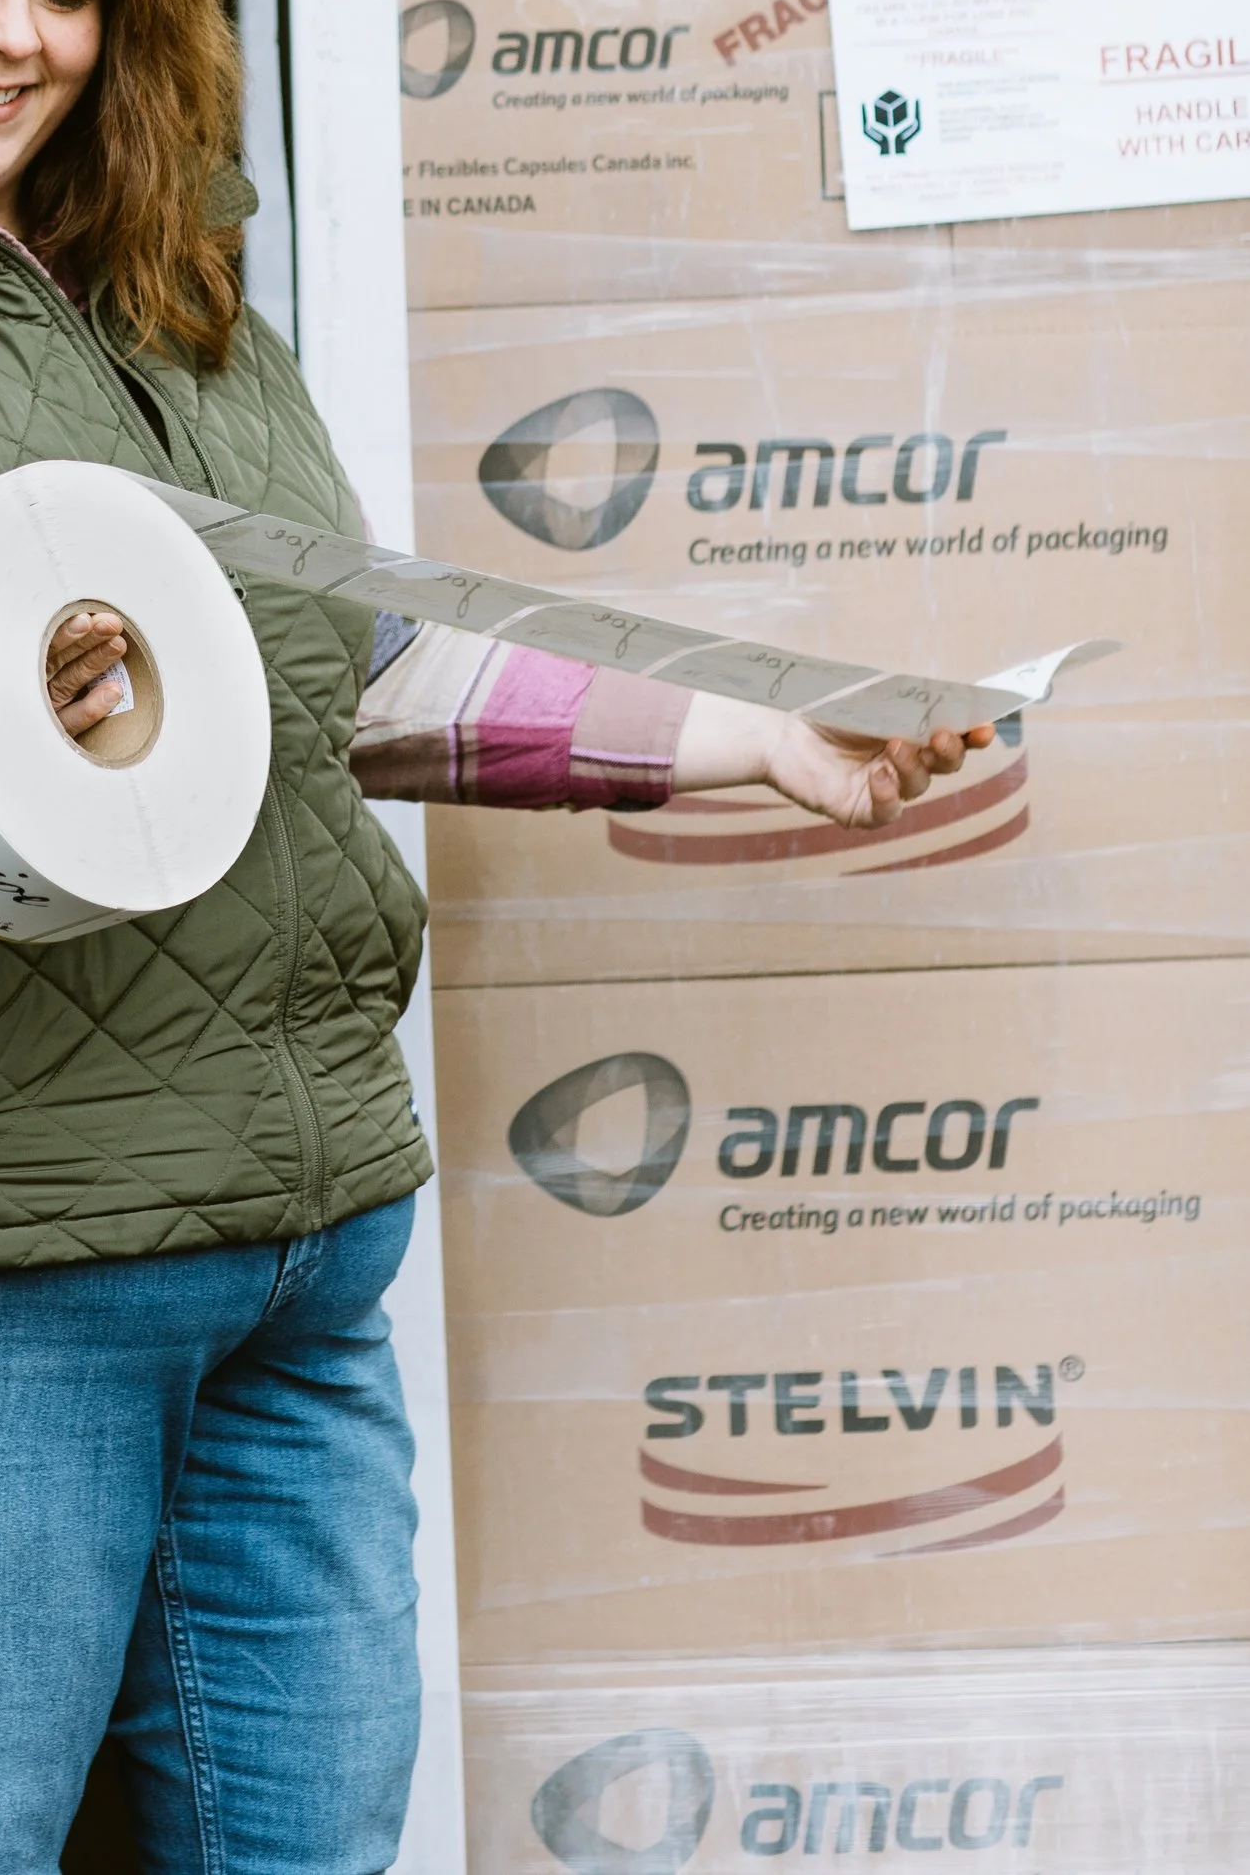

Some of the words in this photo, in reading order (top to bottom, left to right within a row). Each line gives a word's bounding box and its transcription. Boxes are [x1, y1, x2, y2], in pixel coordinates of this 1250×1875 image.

[491, 24, 691, 76] amcor
[492, 90, 568, 111] Creating
[571, 94, 583, 106] a
[585, 92, 622, 107] new
[626, 87, 677, 105] world
[681, 84, 700, 103] of
[700, 82, 791, 110] packaging
[1136, 96, 1249, 126] HANDLE
[419, 159, 500, 178] Flexibles
[503, 155, 588, 178] Capsules
[592, 153, 663, 174] Canada
[1118, 133, 1186, 160] WITH
[420, 197, 441, 216] IN
[446, 193, 537, 216] CANADA
[686, 430, 1009, 513] amcor
[688, 536, 808, 568] Creating
[816, 541, 832, 561] a
[840, 537, 897, 559] new
[906, 526, 984, 557] world
[992, 525, 1022, 554] of
[1026, 522, 1170, 558] packaging
[717, 1096, 1041, 1179] amcor
[719, 1203, 839, 1235] Creating
[847, 1206, 864, 1227] a
[870, 1204, 928, 1225] new
[938, 1194, 1016, 1223] world
[1024, 1192, 1054, 1220] of
[1058, 1190, 1201, 1226] packaging
[739, 1774, 1065, 1857] amcor
